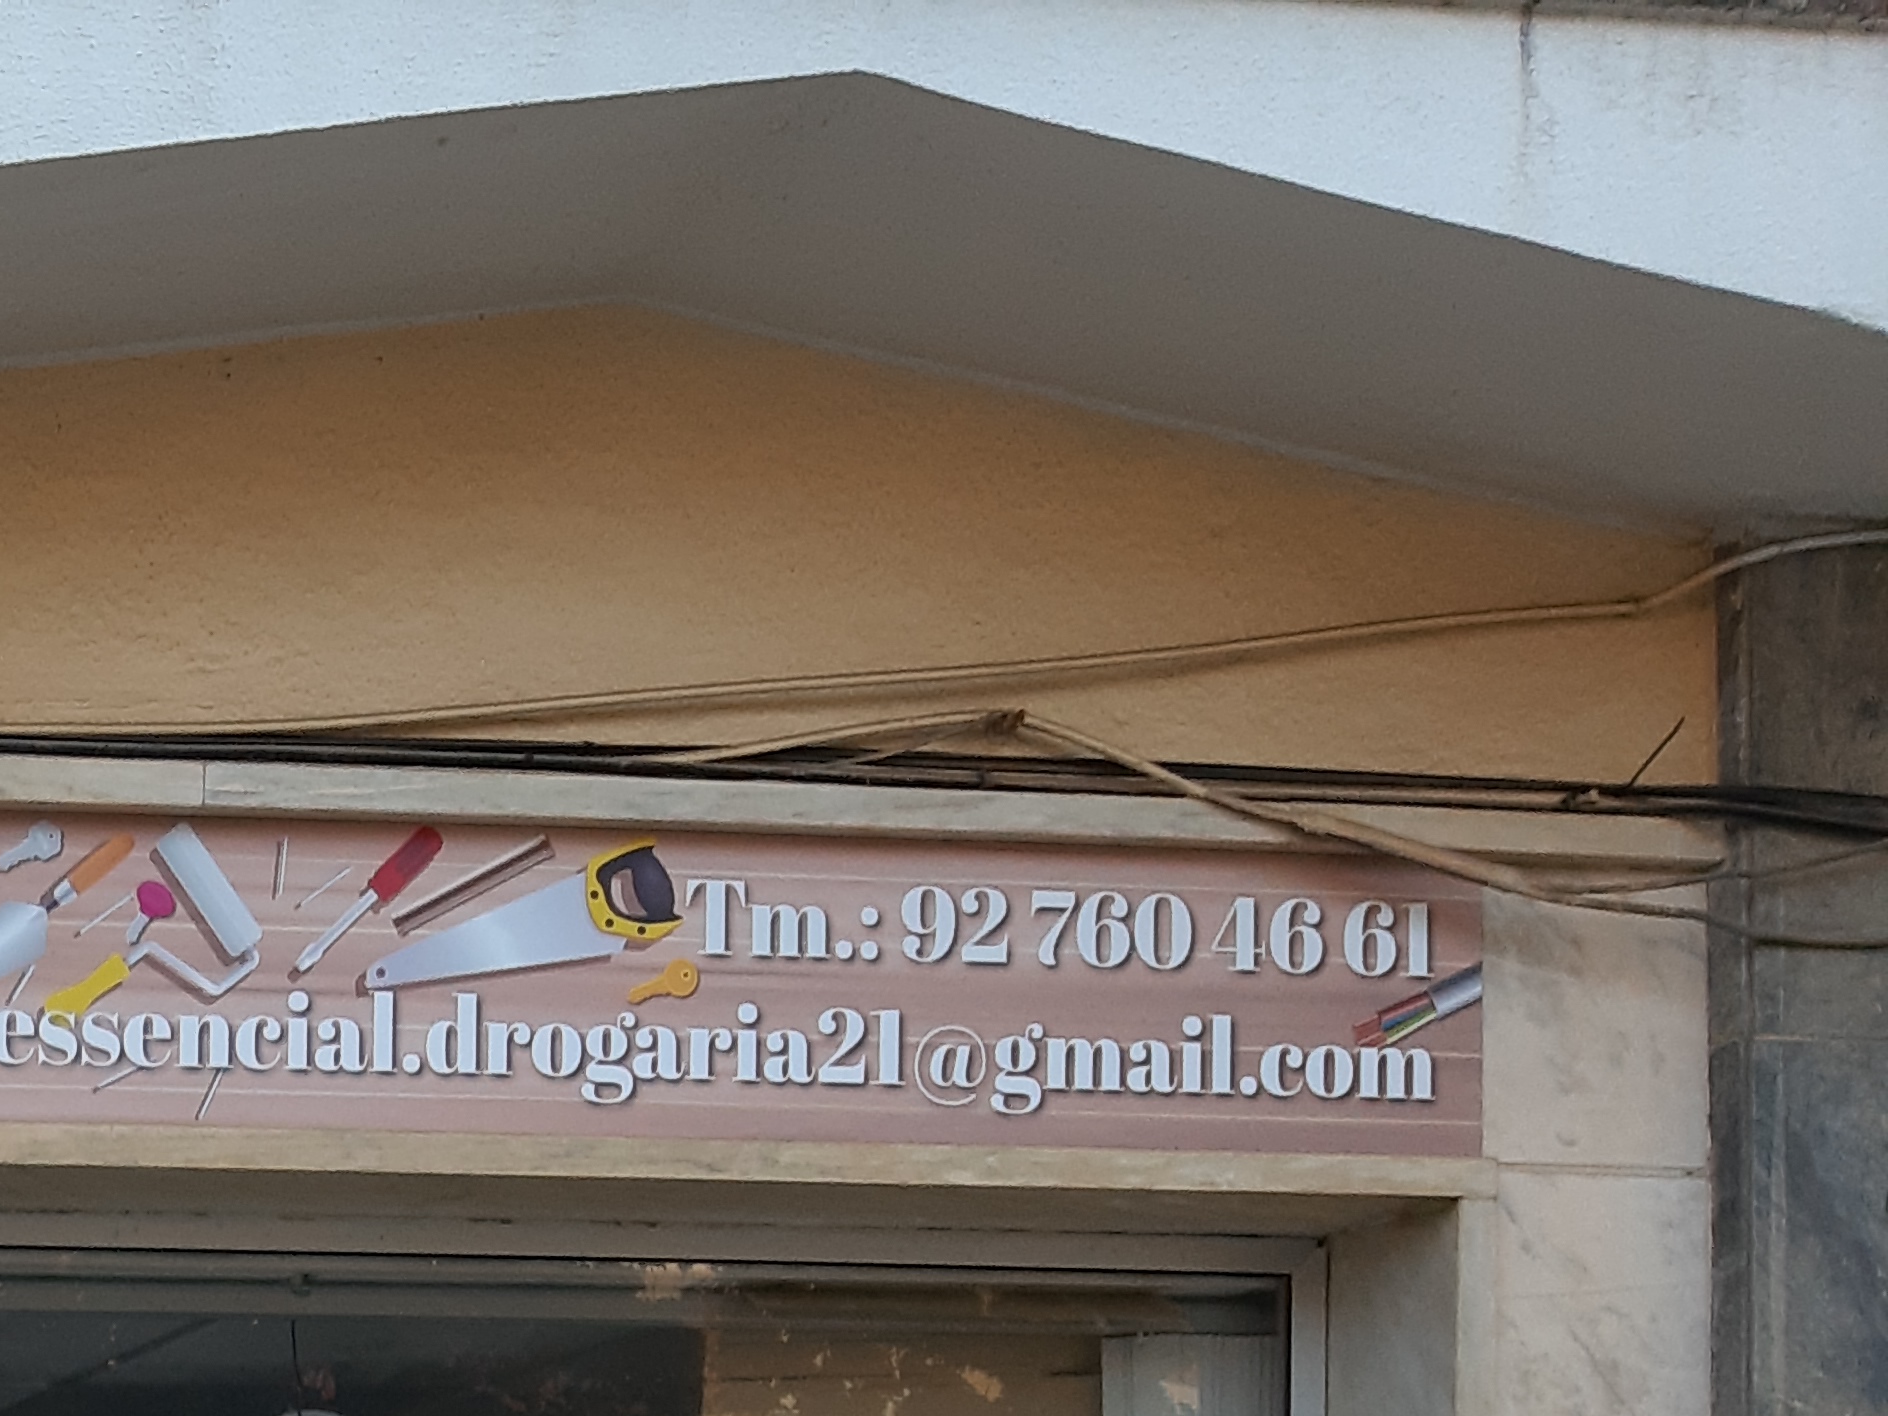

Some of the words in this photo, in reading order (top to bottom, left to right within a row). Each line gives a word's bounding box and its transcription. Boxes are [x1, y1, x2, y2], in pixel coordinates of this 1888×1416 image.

[684, 879, 880, 963] Tm.:
[900, 884, 1009, 966] 92
[1029, 888, 1195, 972] 760
[1211, 895, 1325, 976] 46
[1342, 901, 1436, 979] 61
